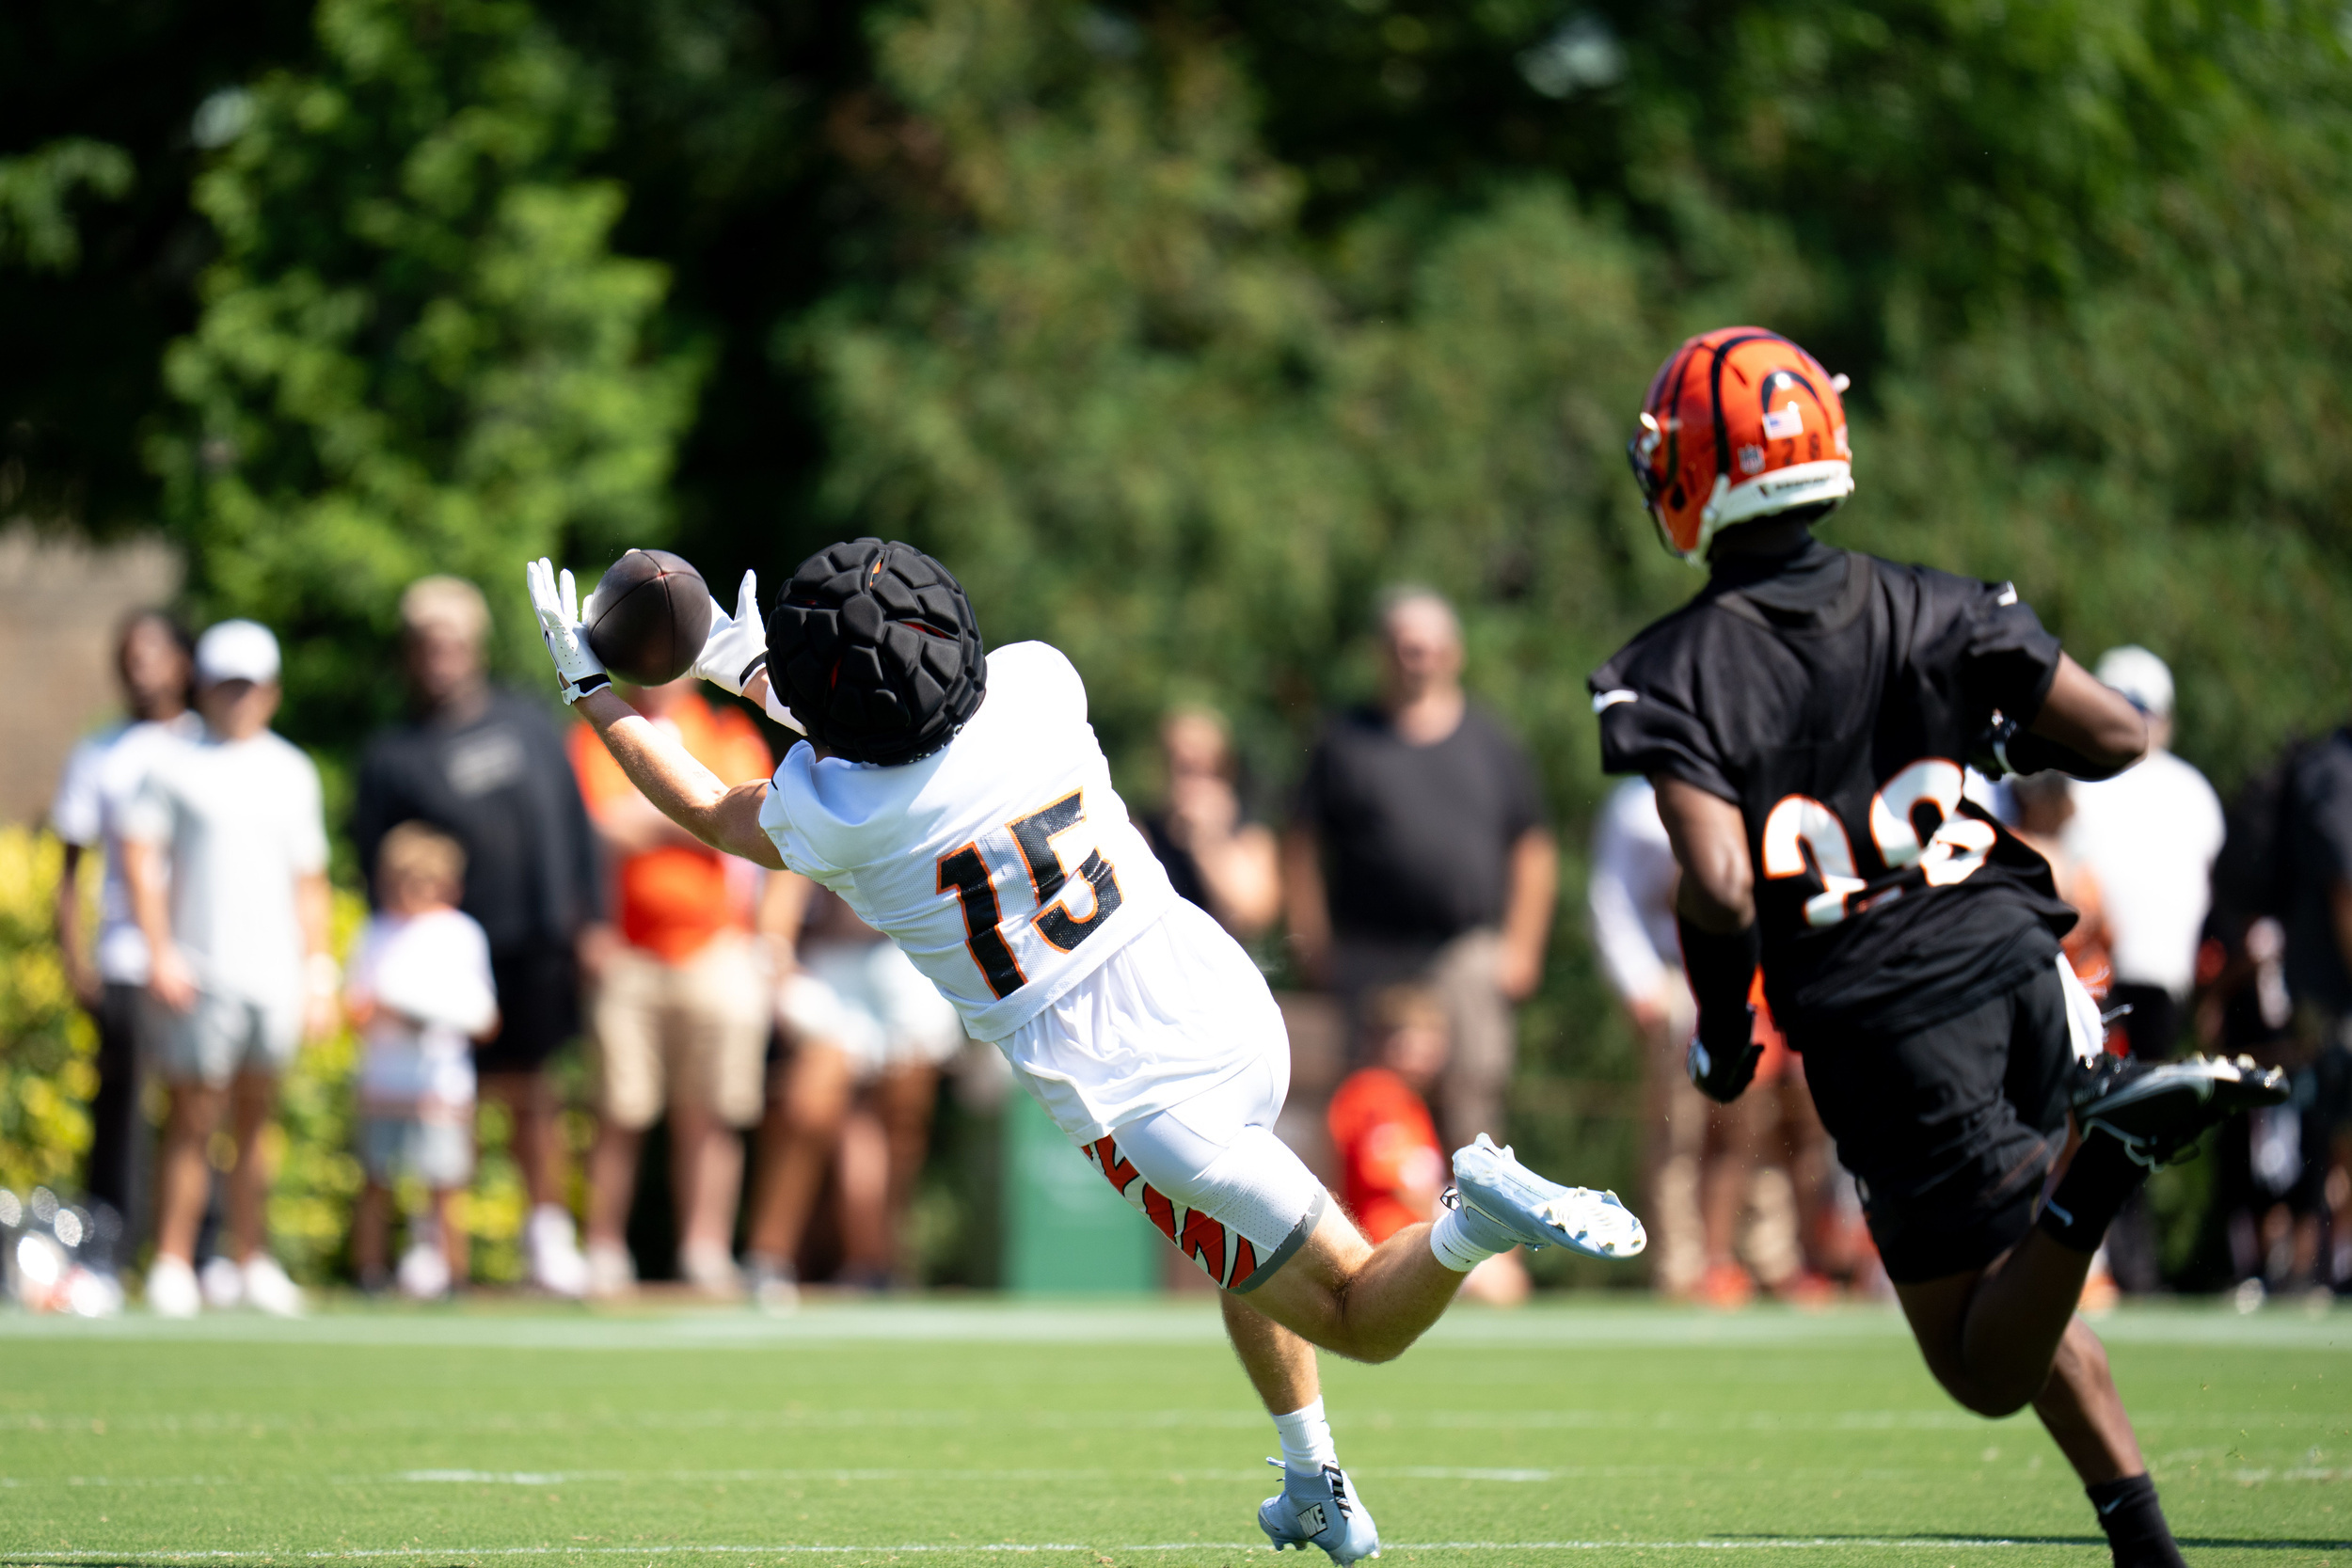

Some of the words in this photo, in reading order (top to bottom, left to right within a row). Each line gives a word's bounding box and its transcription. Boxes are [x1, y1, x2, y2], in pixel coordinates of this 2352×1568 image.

[936, 785, 1125, 1001] 15
[1761, 755, 1997, 927] 28
[1297, 1502, 1328, 1539] NIKE
